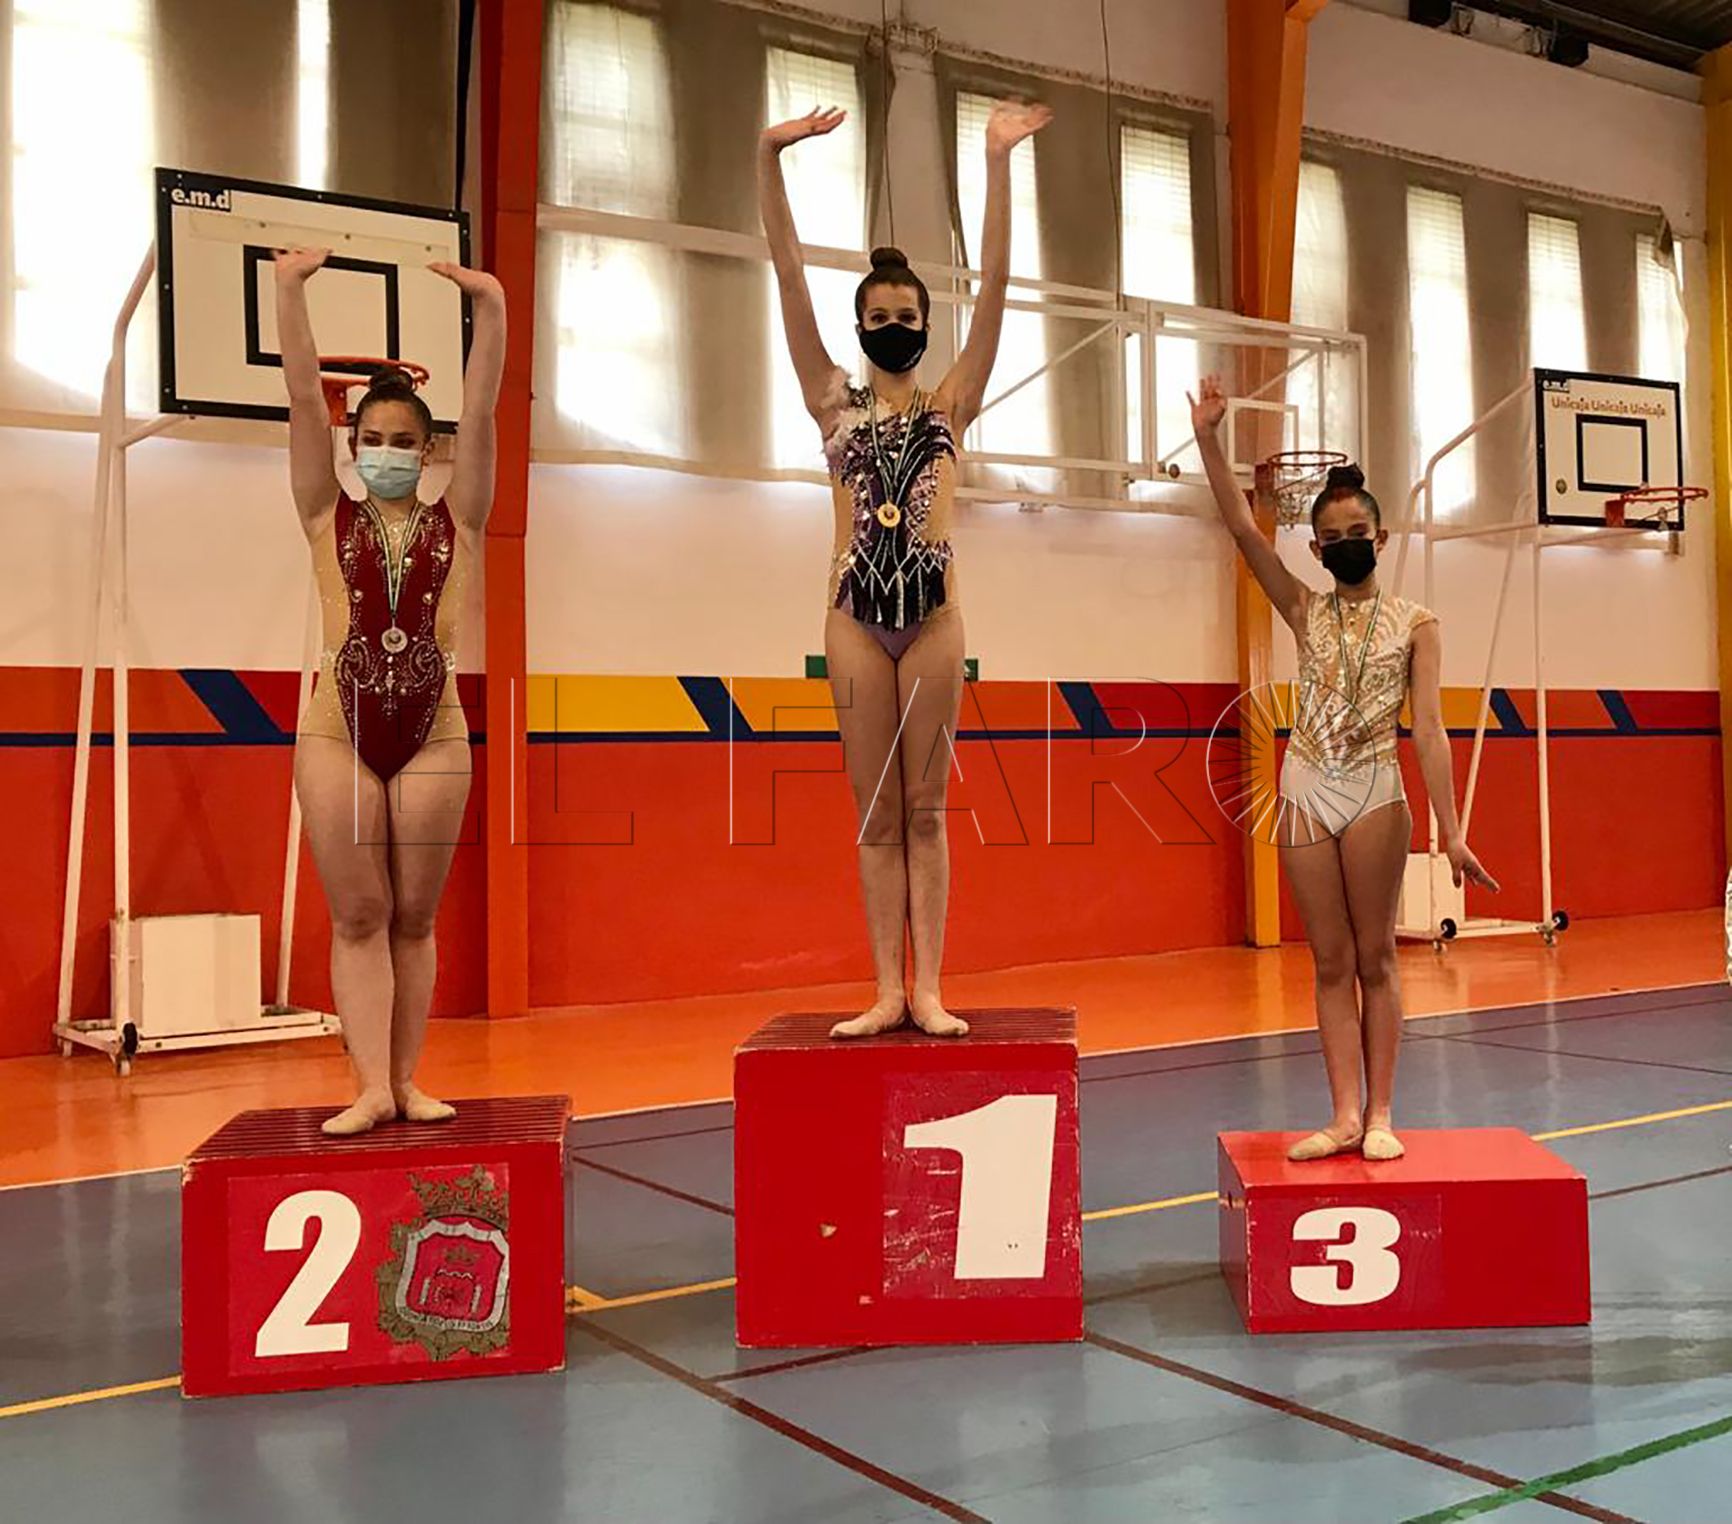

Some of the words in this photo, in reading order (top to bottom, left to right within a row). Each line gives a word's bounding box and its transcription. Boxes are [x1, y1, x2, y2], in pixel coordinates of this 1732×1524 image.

[1551, 396, 1590, 412] Unicaja
[1591, 399, 1629, 415] Unicaja
[1630, 402, 1667, 418] Unicaja
[903, 1094, 1058, 1280] 1
[254, 1189, 362, 1358] 2
[1290, 1206, 1401, 1306] 3
